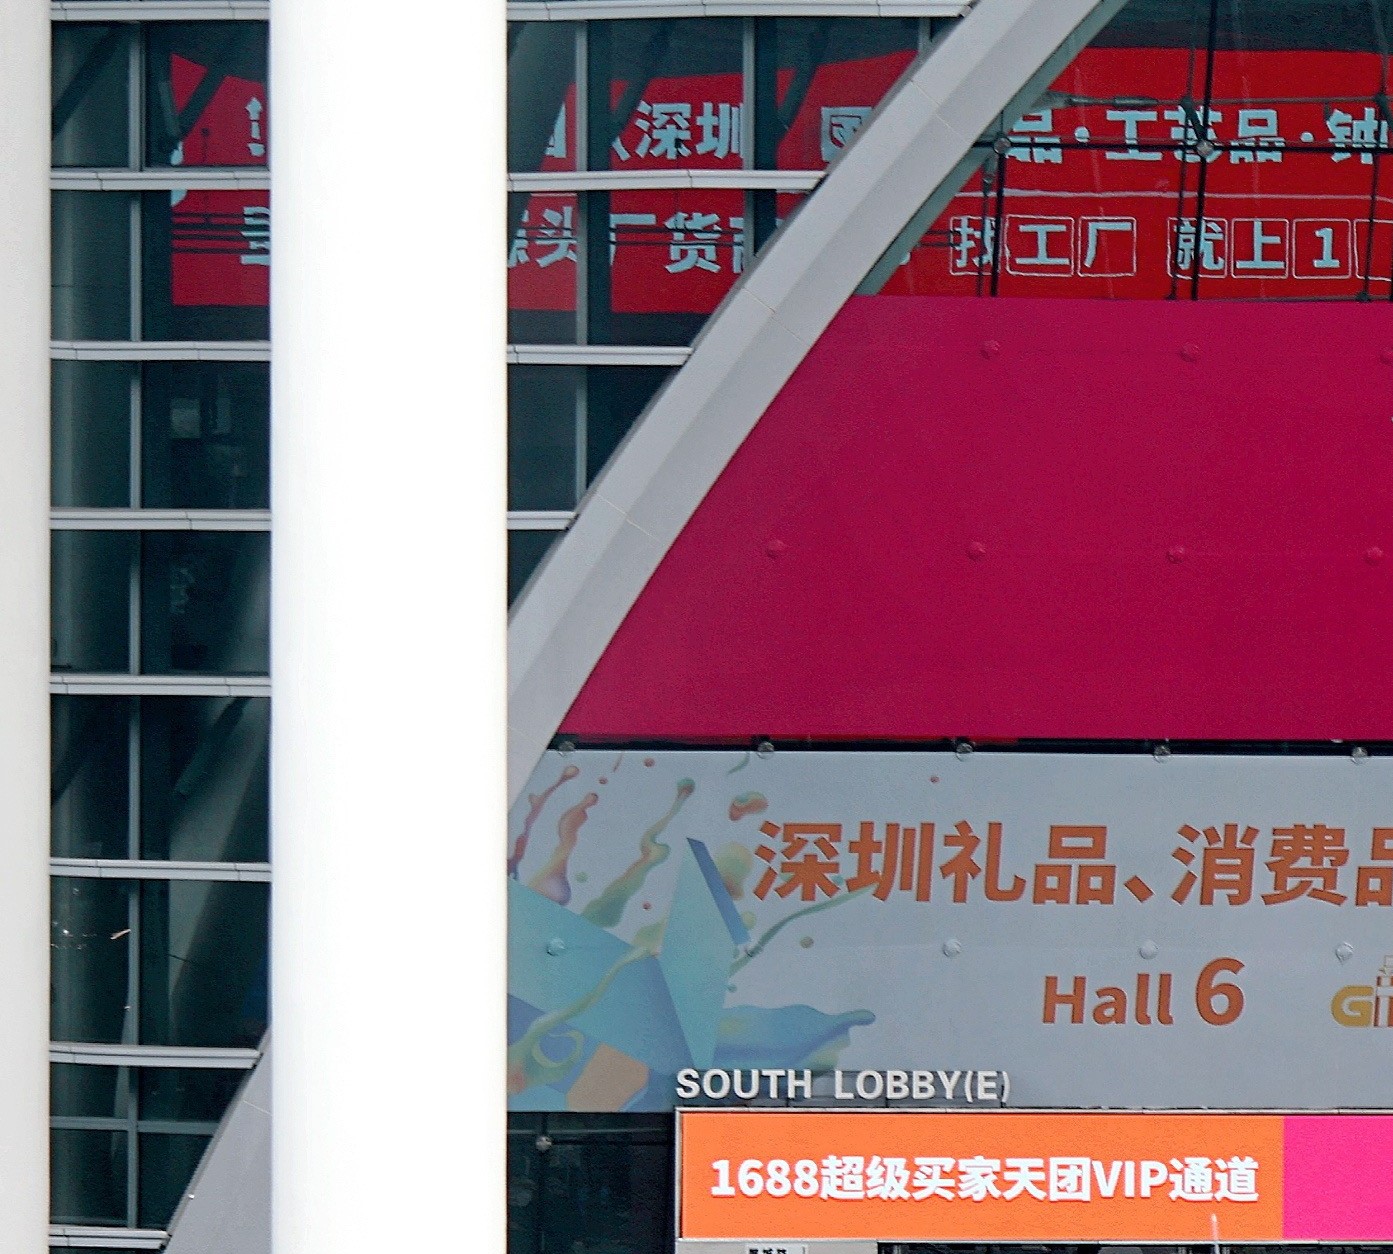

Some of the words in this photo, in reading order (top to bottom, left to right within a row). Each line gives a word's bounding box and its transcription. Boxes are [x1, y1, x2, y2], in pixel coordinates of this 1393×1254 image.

[955, 217, 1133, 272] 找工厂
[1043, 974, 1173, 1027] Hall
[1195, 957, 1246, 1027] 6
[676, 1068, 813, 1101] SOUTH
[834, 1068, 1011, 1102] LOBBY(E)
[710, 1155, 1260, 1204] 1688超级买家天团VIP通道
